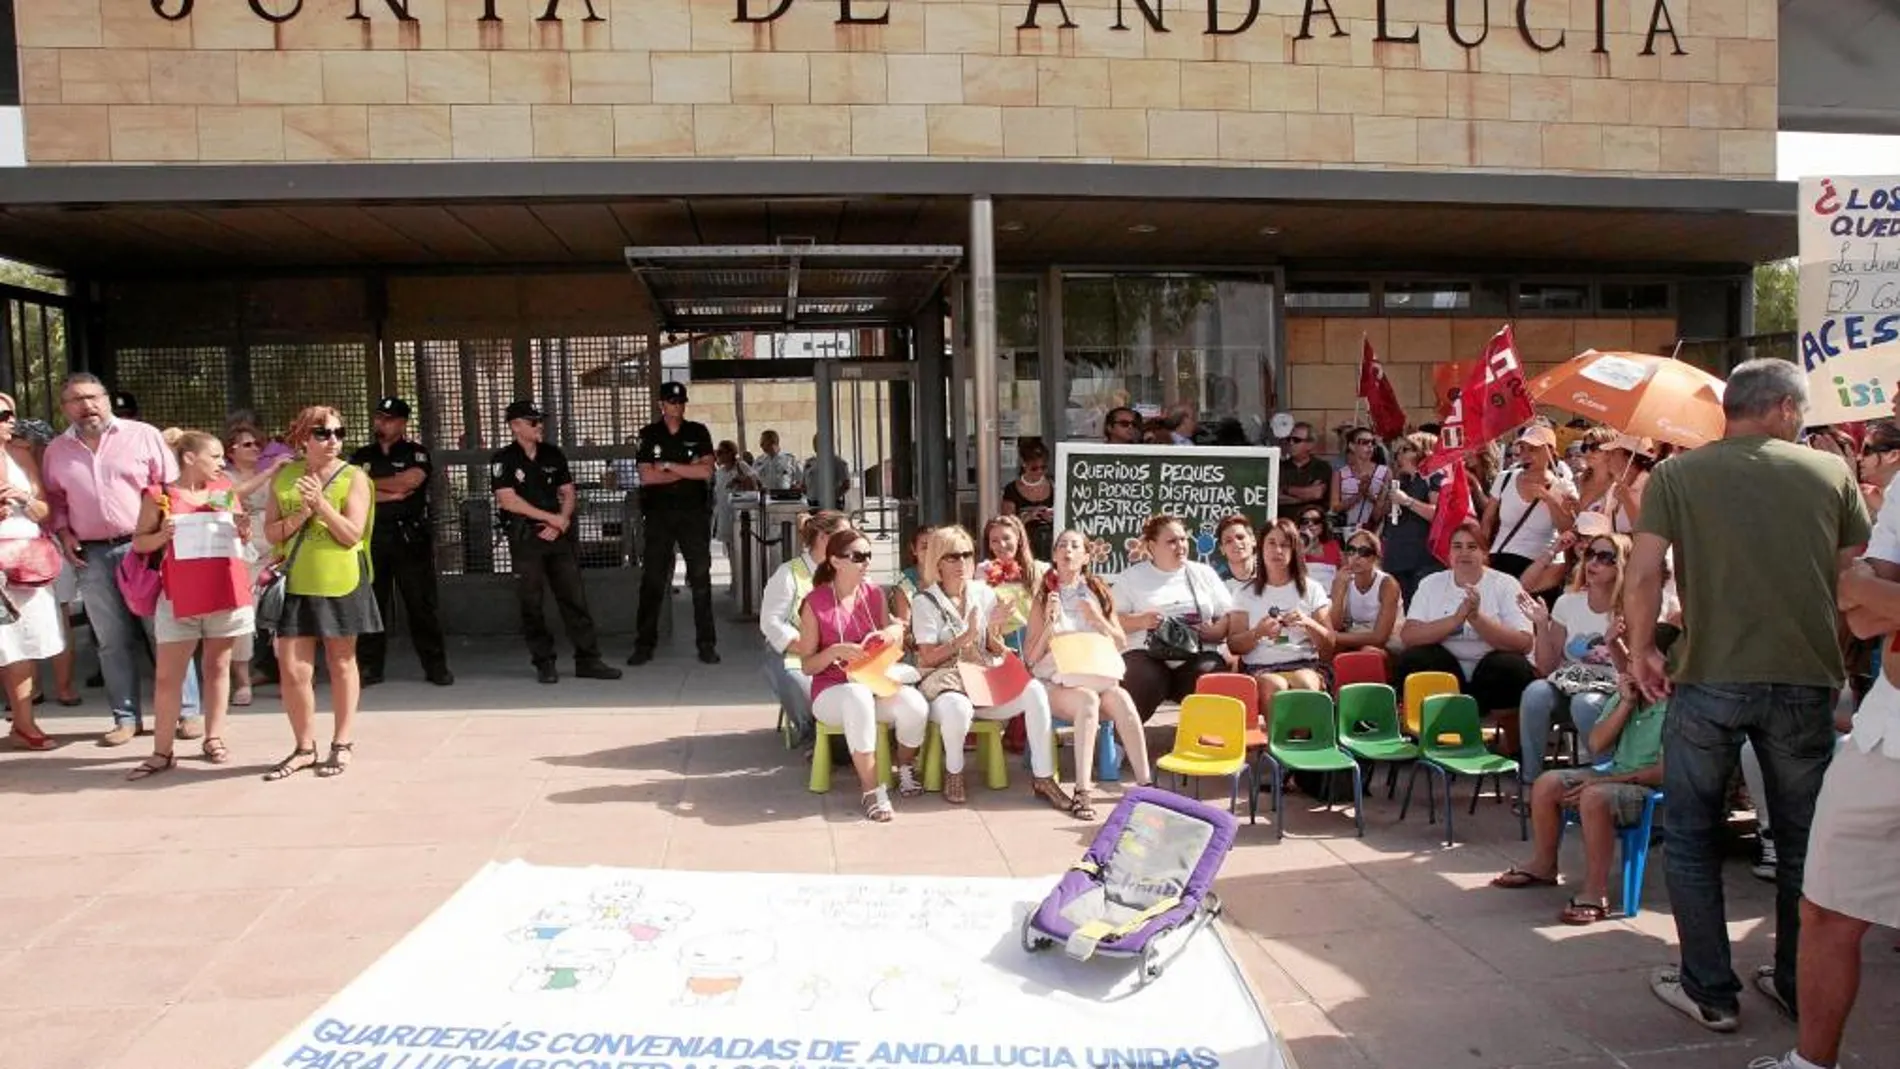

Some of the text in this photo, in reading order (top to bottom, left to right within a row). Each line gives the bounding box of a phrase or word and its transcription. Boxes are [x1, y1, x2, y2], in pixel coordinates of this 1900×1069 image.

[1160, 463, 1225, 482] PEQUES
[1243, 485, 1267, 506] DE
[1071, 499, 1152, 516] VUESTROS
[547, 1032, 802, 1061] CONVENIADAS
[807, 1038, 861, 1063] DE
[866, 1041, 1078, 1068] ANDALUCIA
[1085, 1046, 1220, 1069] UNIDAS
